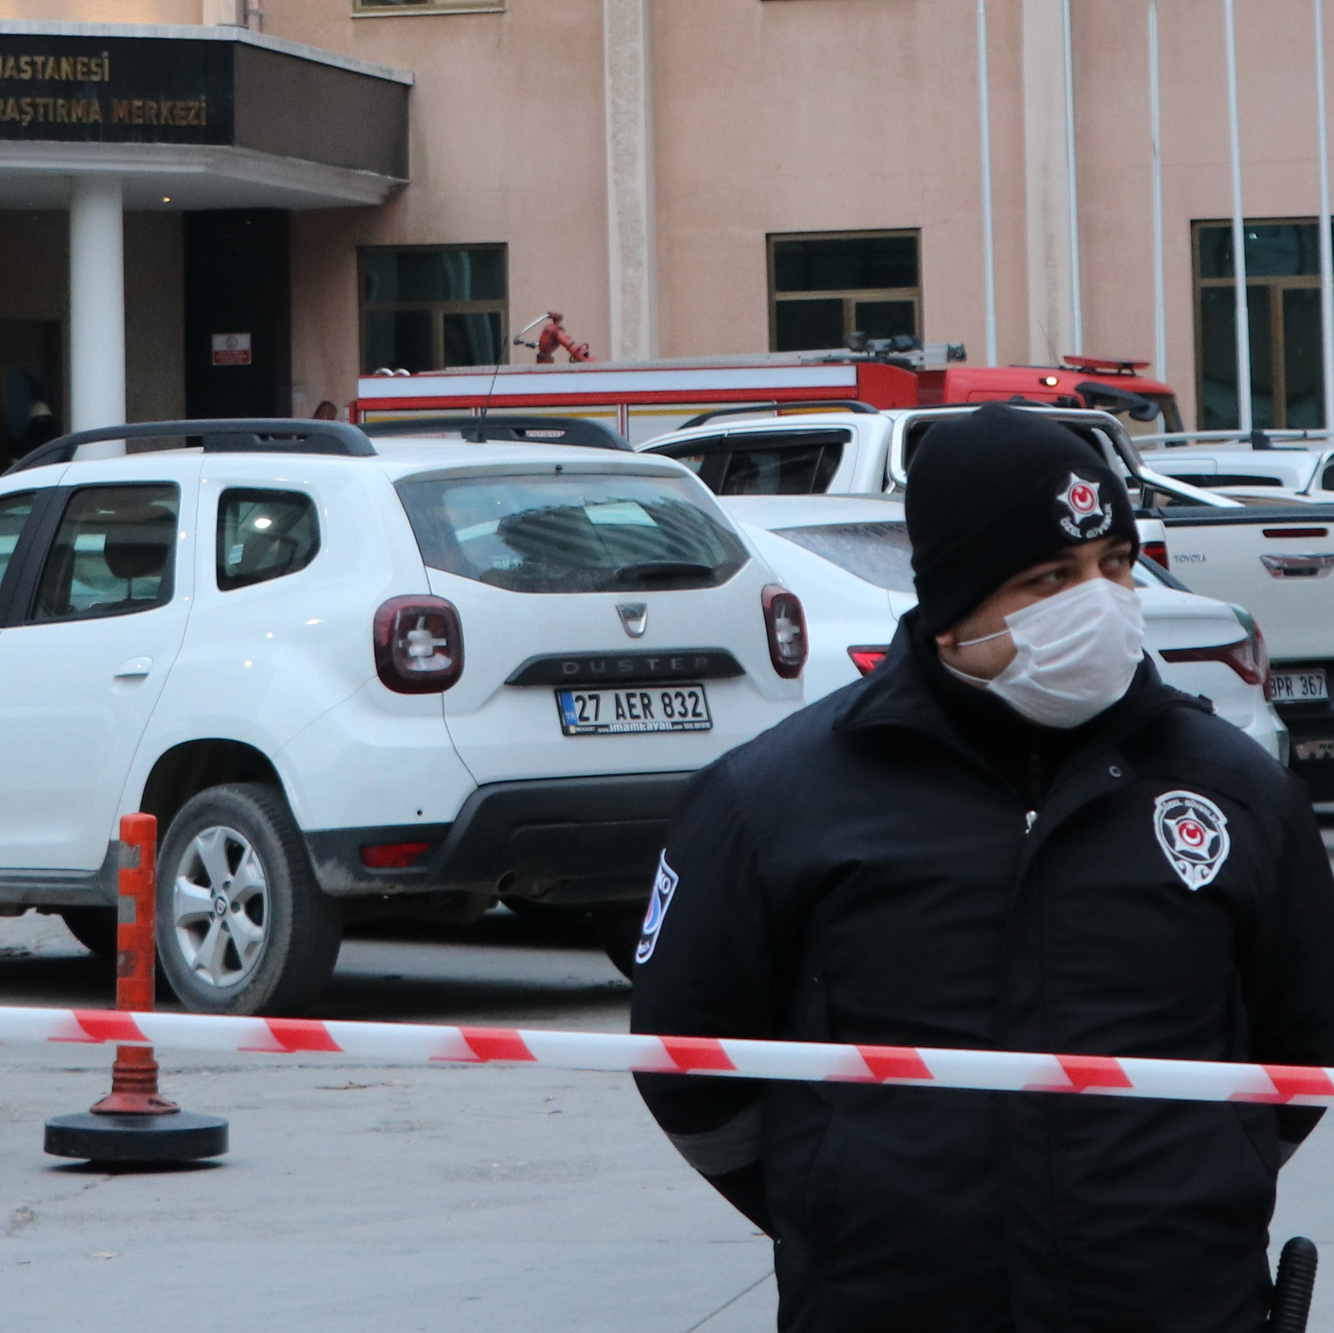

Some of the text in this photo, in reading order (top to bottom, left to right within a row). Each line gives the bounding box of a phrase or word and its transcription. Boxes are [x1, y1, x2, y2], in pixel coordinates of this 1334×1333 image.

[112, 96, 206, 126] MERKEZİ
[562, 657, 709, 675] DUSTER
[1300, 675, 1324, 697] 367
[575, 691, 703, 722] 27 AER 832
